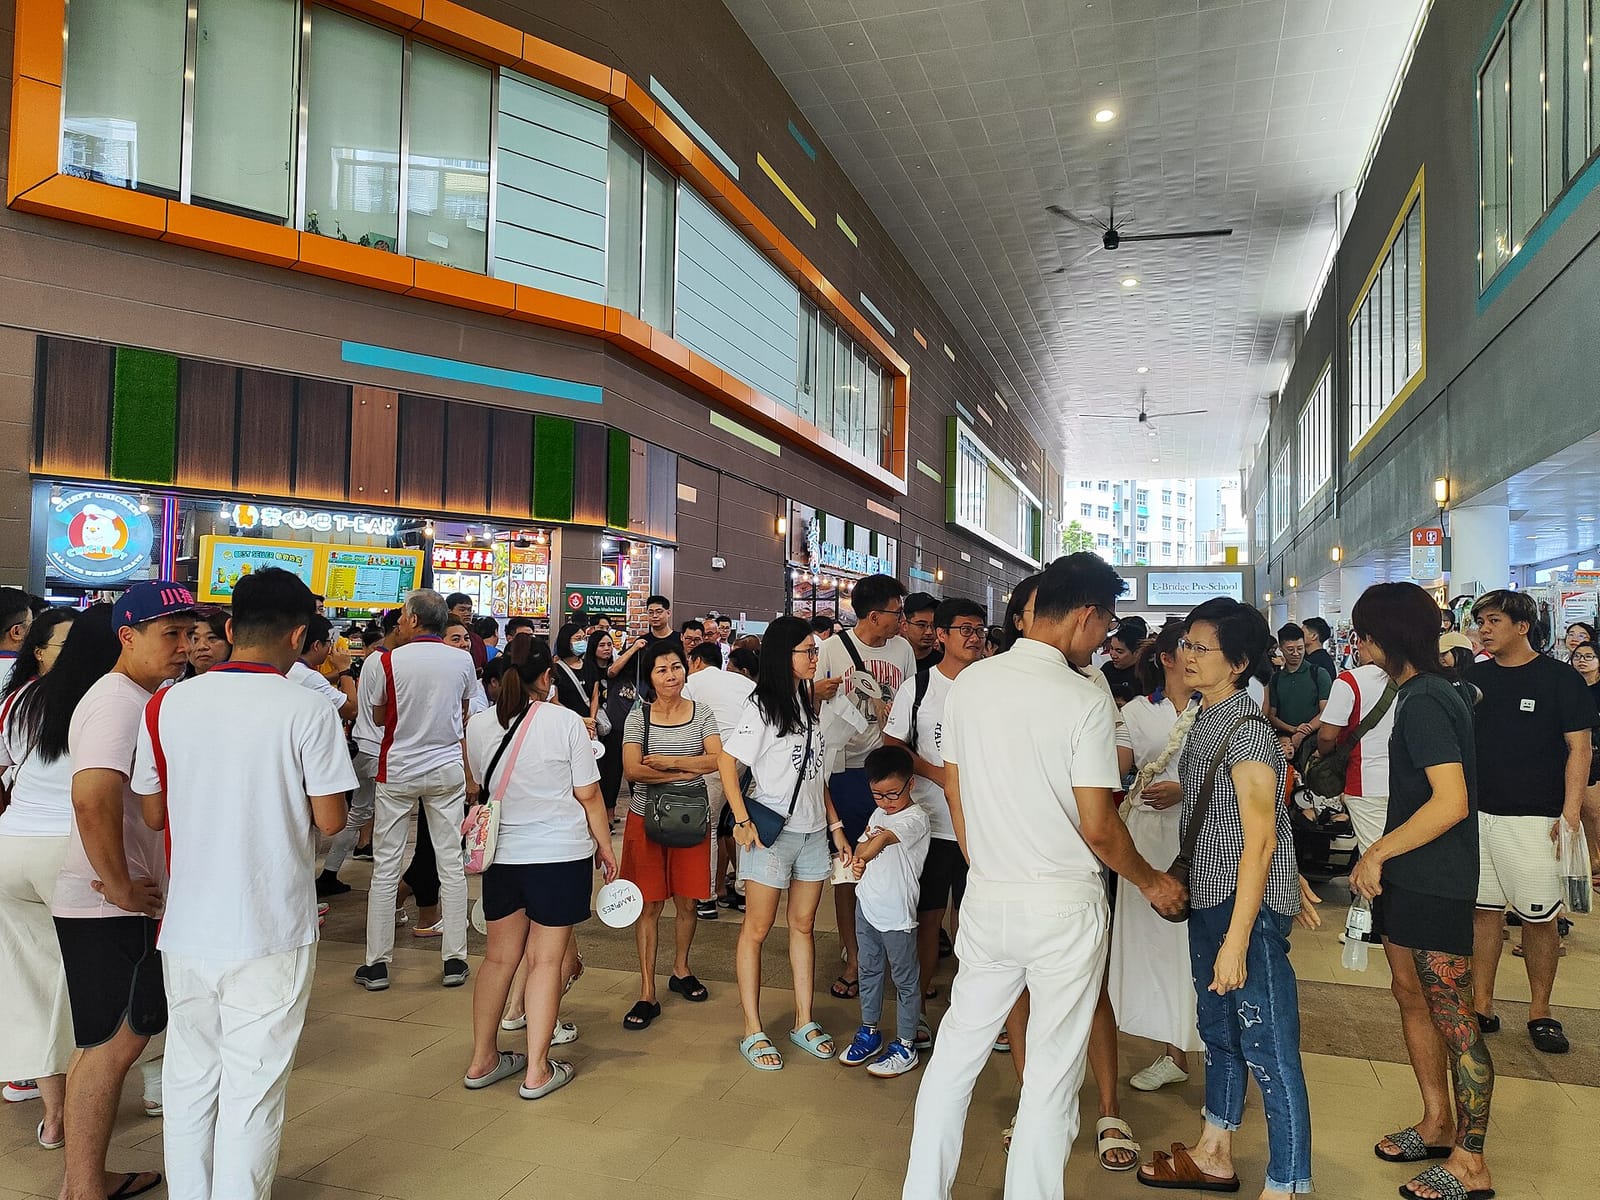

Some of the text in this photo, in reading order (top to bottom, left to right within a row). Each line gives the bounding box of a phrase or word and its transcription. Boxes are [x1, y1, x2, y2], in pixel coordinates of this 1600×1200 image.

[55, 491, 142, 517] CRISPY CHICKEN
[52, 552, 65, 565] ALL
[234, 550, 251, 559] BEST
[251, 550, 274, 560] SELLER
[1152, 582, 1238, 592] E-Bridge Pre-School
[586, 595, 626, 606] ISTANBUL
